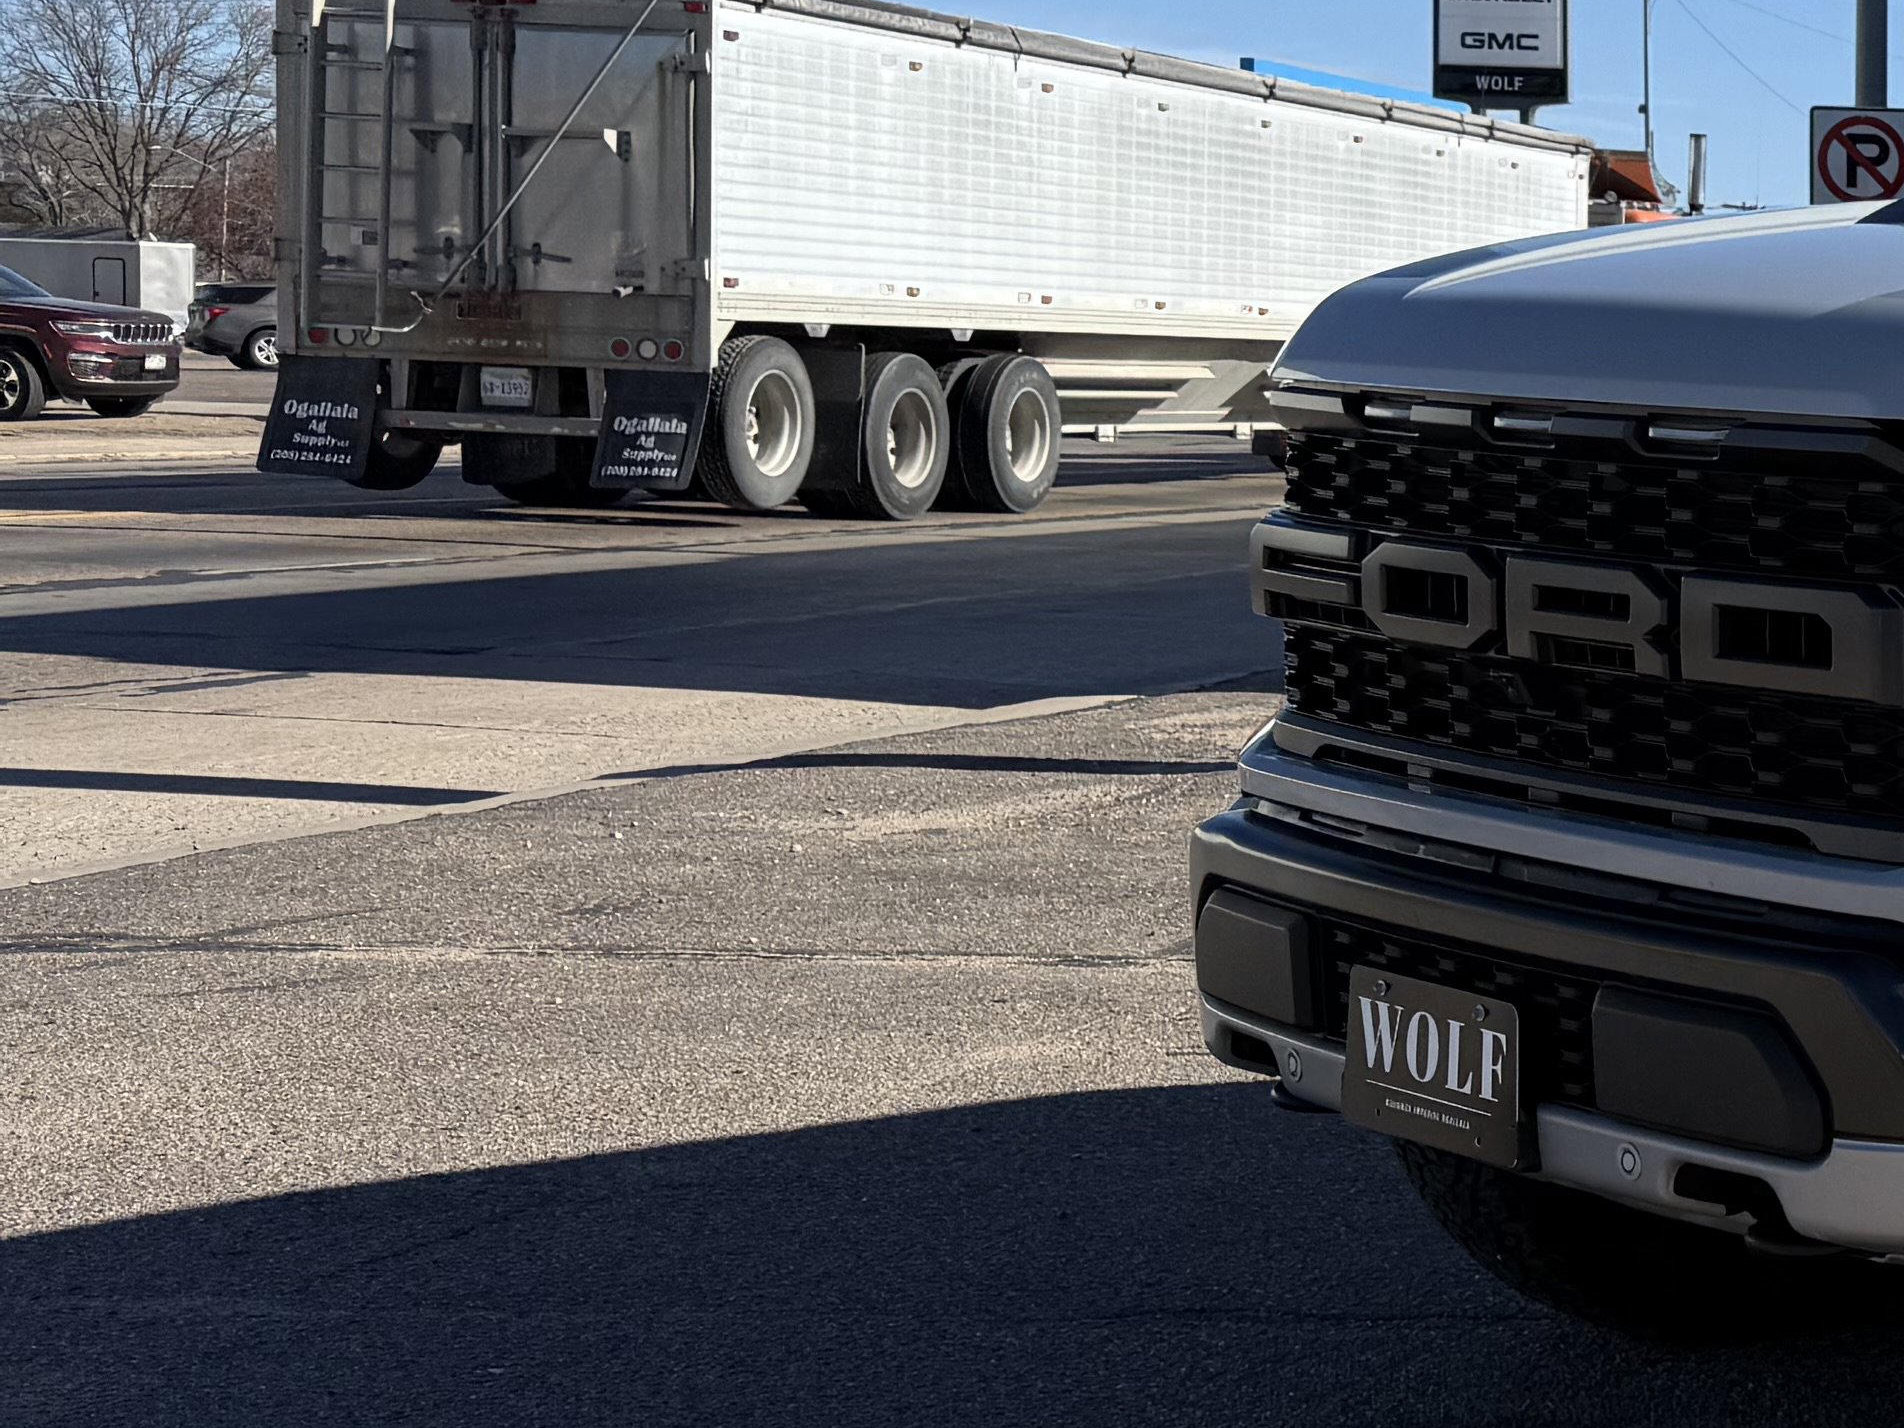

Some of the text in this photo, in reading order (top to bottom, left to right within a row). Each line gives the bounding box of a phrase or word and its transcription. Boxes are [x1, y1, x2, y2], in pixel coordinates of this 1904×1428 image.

[1460, 31, 1540, 51] GMC
[1475, 74, 1524, 91] WOLF
[283, 399, 359, 419] Ogallala
[613, 415, 688, 435] Ogallala
[292, 432, 336, 447] Supply
[1358, 995, 1508, 1103] WOLF
